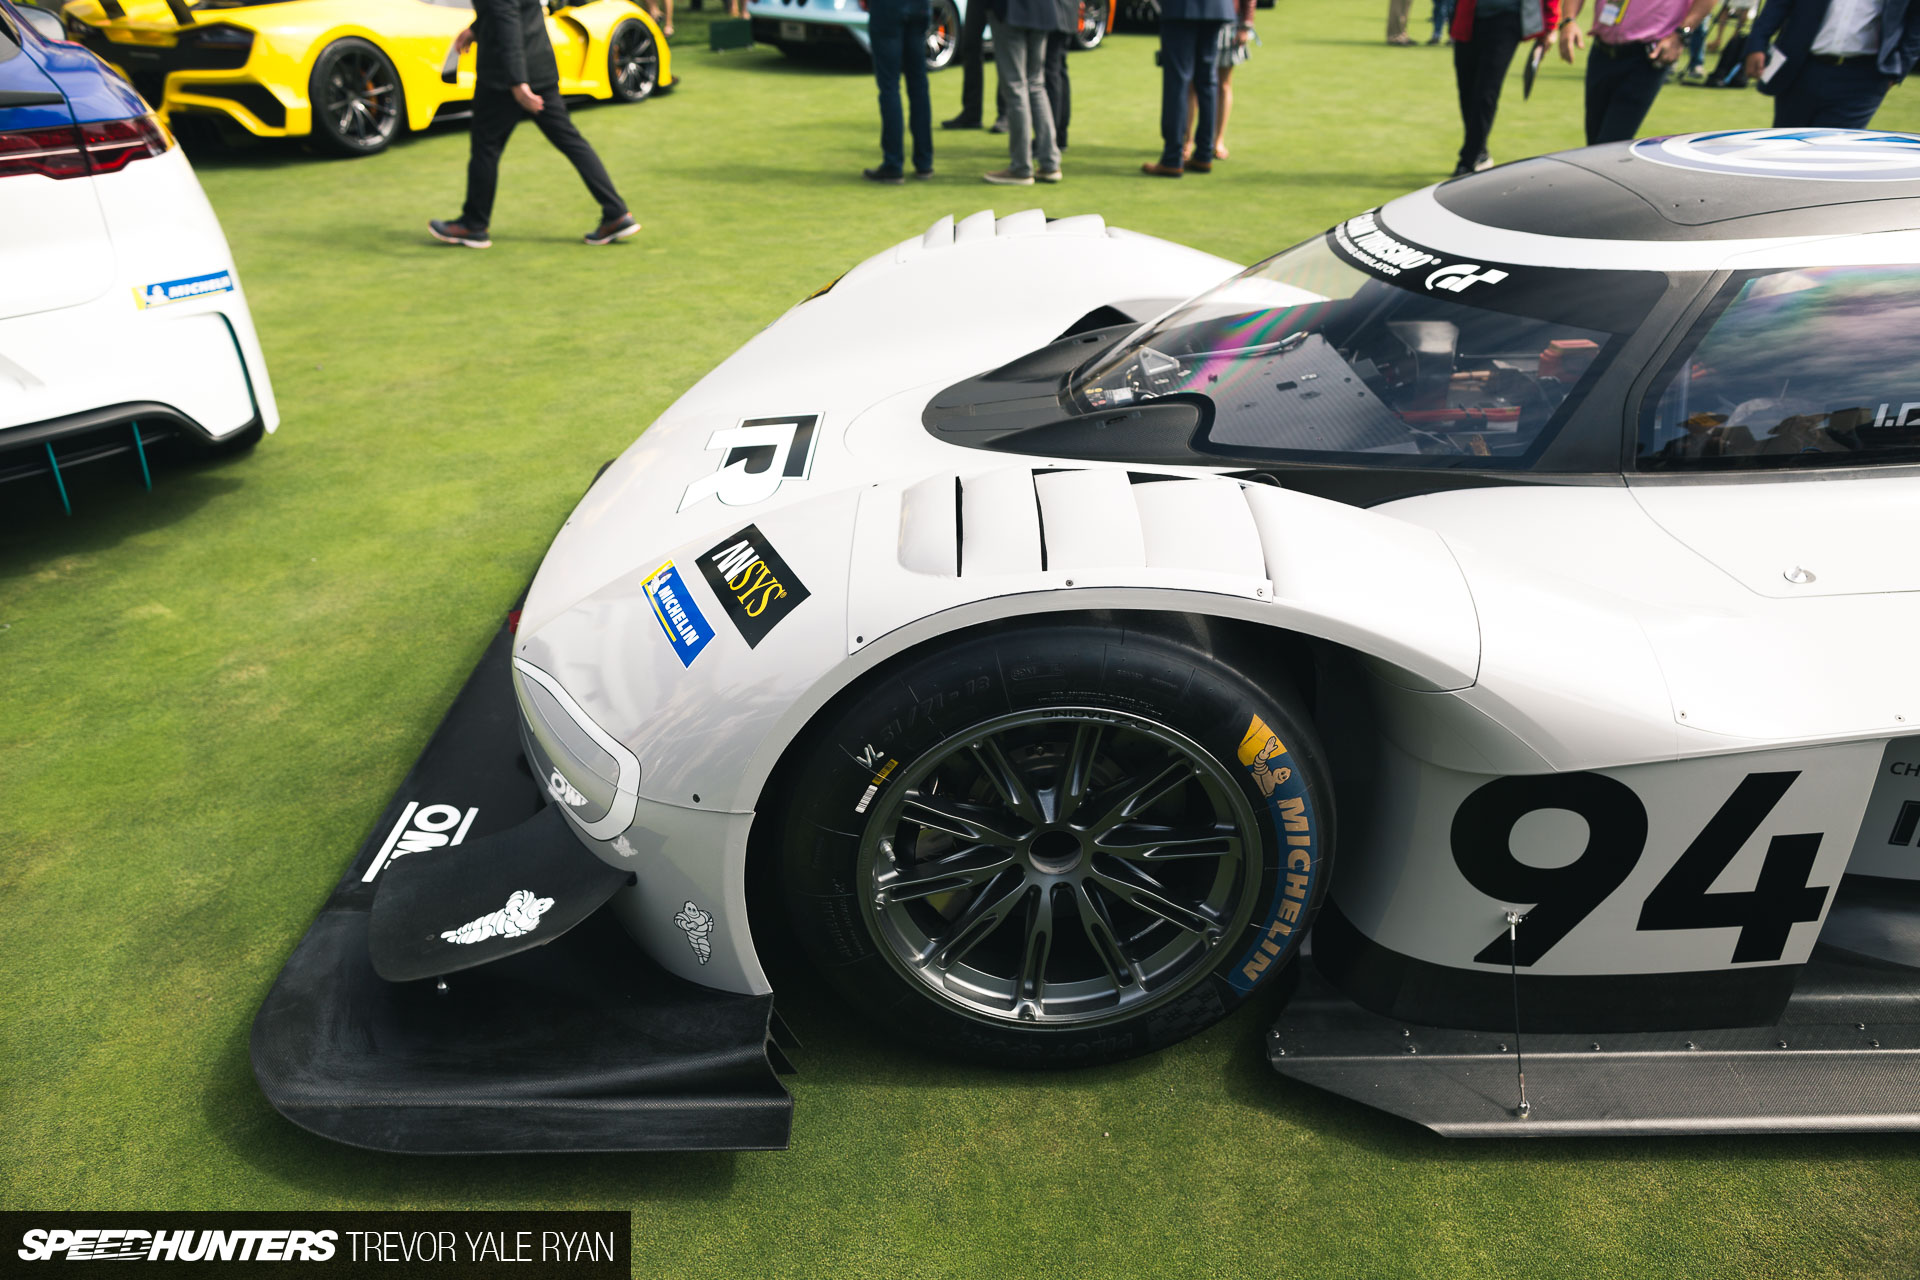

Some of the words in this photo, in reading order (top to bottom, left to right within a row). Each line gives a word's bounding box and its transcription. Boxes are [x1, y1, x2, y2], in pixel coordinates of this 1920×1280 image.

[657, 585, 700, 647] MICHELIN
[1042, 709, 1111, 721] RACING
[1241, 796, 1312, 982] MICHELIN
[1450, 770, 1830, 967] 94
